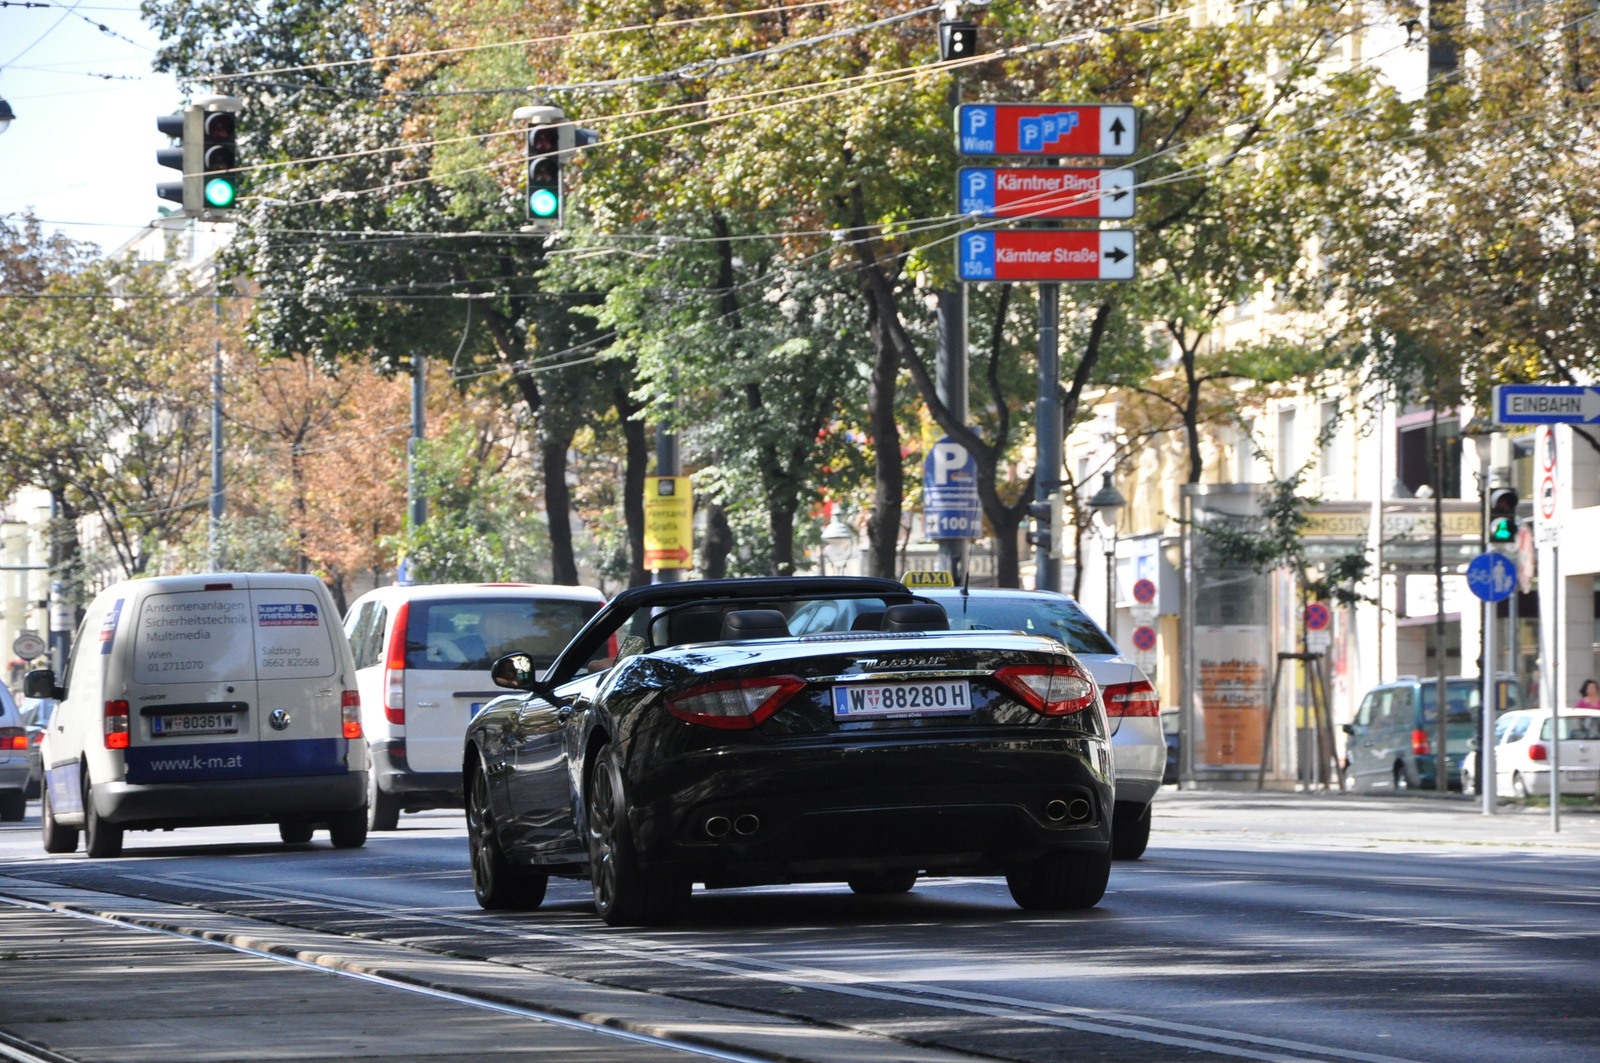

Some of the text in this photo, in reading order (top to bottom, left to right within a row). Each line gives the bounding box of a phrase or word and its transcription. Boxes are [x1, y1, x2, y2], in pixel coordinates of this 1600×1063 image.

[963, 137, 994, 151] Wien
[997, 174, 1097, 192] Kärntner Ring
[996, 247, 1098, 262] Kärntner Straße
[964, 262, 983, 275] 150
[1512, 396, 1582, 413] EINBAHN
[934, 443, 968, 485] P
[940, 517, 967, 530] 100
[911, 572, 949, 584] TAXI
[145, 601, 245, 613] Antennenanlagen
[295, 604, 305, 612] &
[146, 615, 247, 628] Sicherheitstechnik
[260, 612, 317, 620] matausch
[146, 630, 211, 642] Multimedia
[147, 651, 173, 660] Wien
[262, 646, 300, 657] Salzburg
[148, 661, 204, 672] 01 2711070
[263, 658, 285, 668] 0662
[850, 689, 865, 711] W
[882, 686, 947, 709] 88280
[150, 754, 243, 771] www.k-m.at
